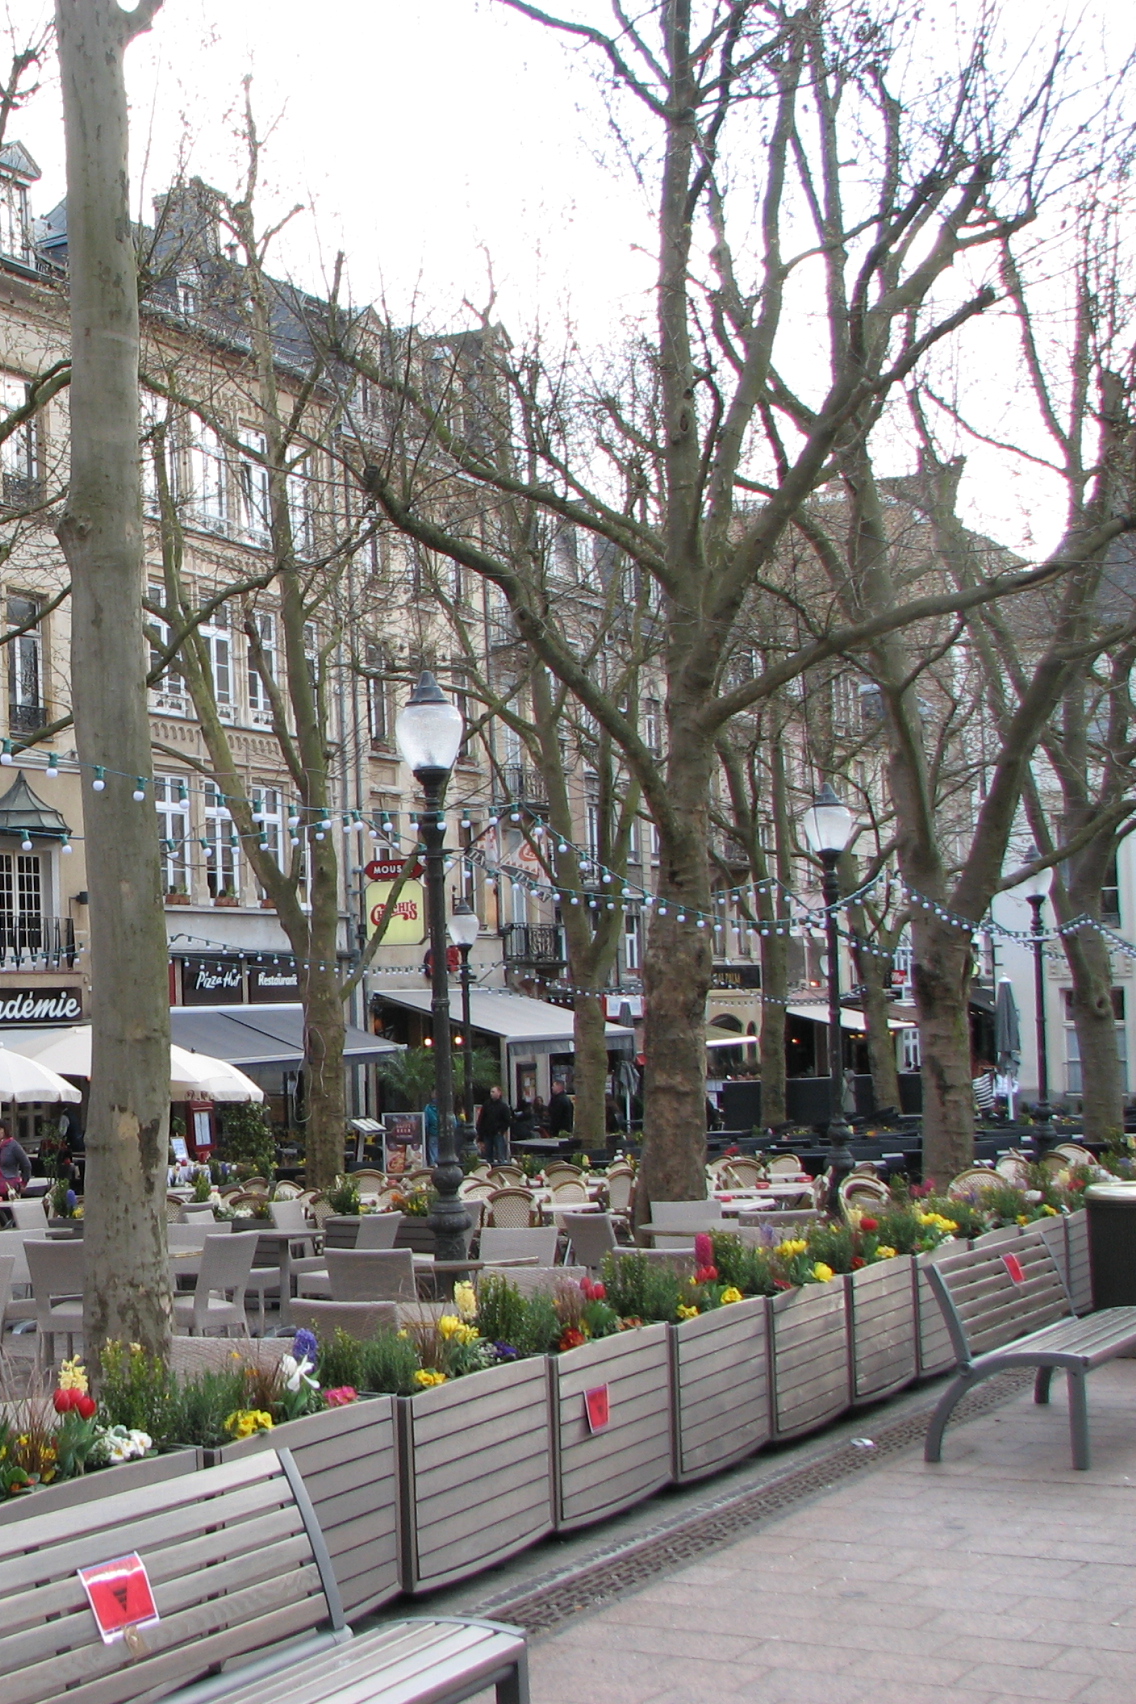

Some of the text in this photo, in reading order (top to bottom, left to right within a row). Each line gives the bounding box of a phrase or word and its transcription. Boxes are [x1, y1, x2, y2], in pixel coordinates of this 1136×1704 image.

[373, 865, 402, 874] MOUS
[196, 971, 242, 989] Pizza Hut
[258, 972, 297, 986] Restaurant
